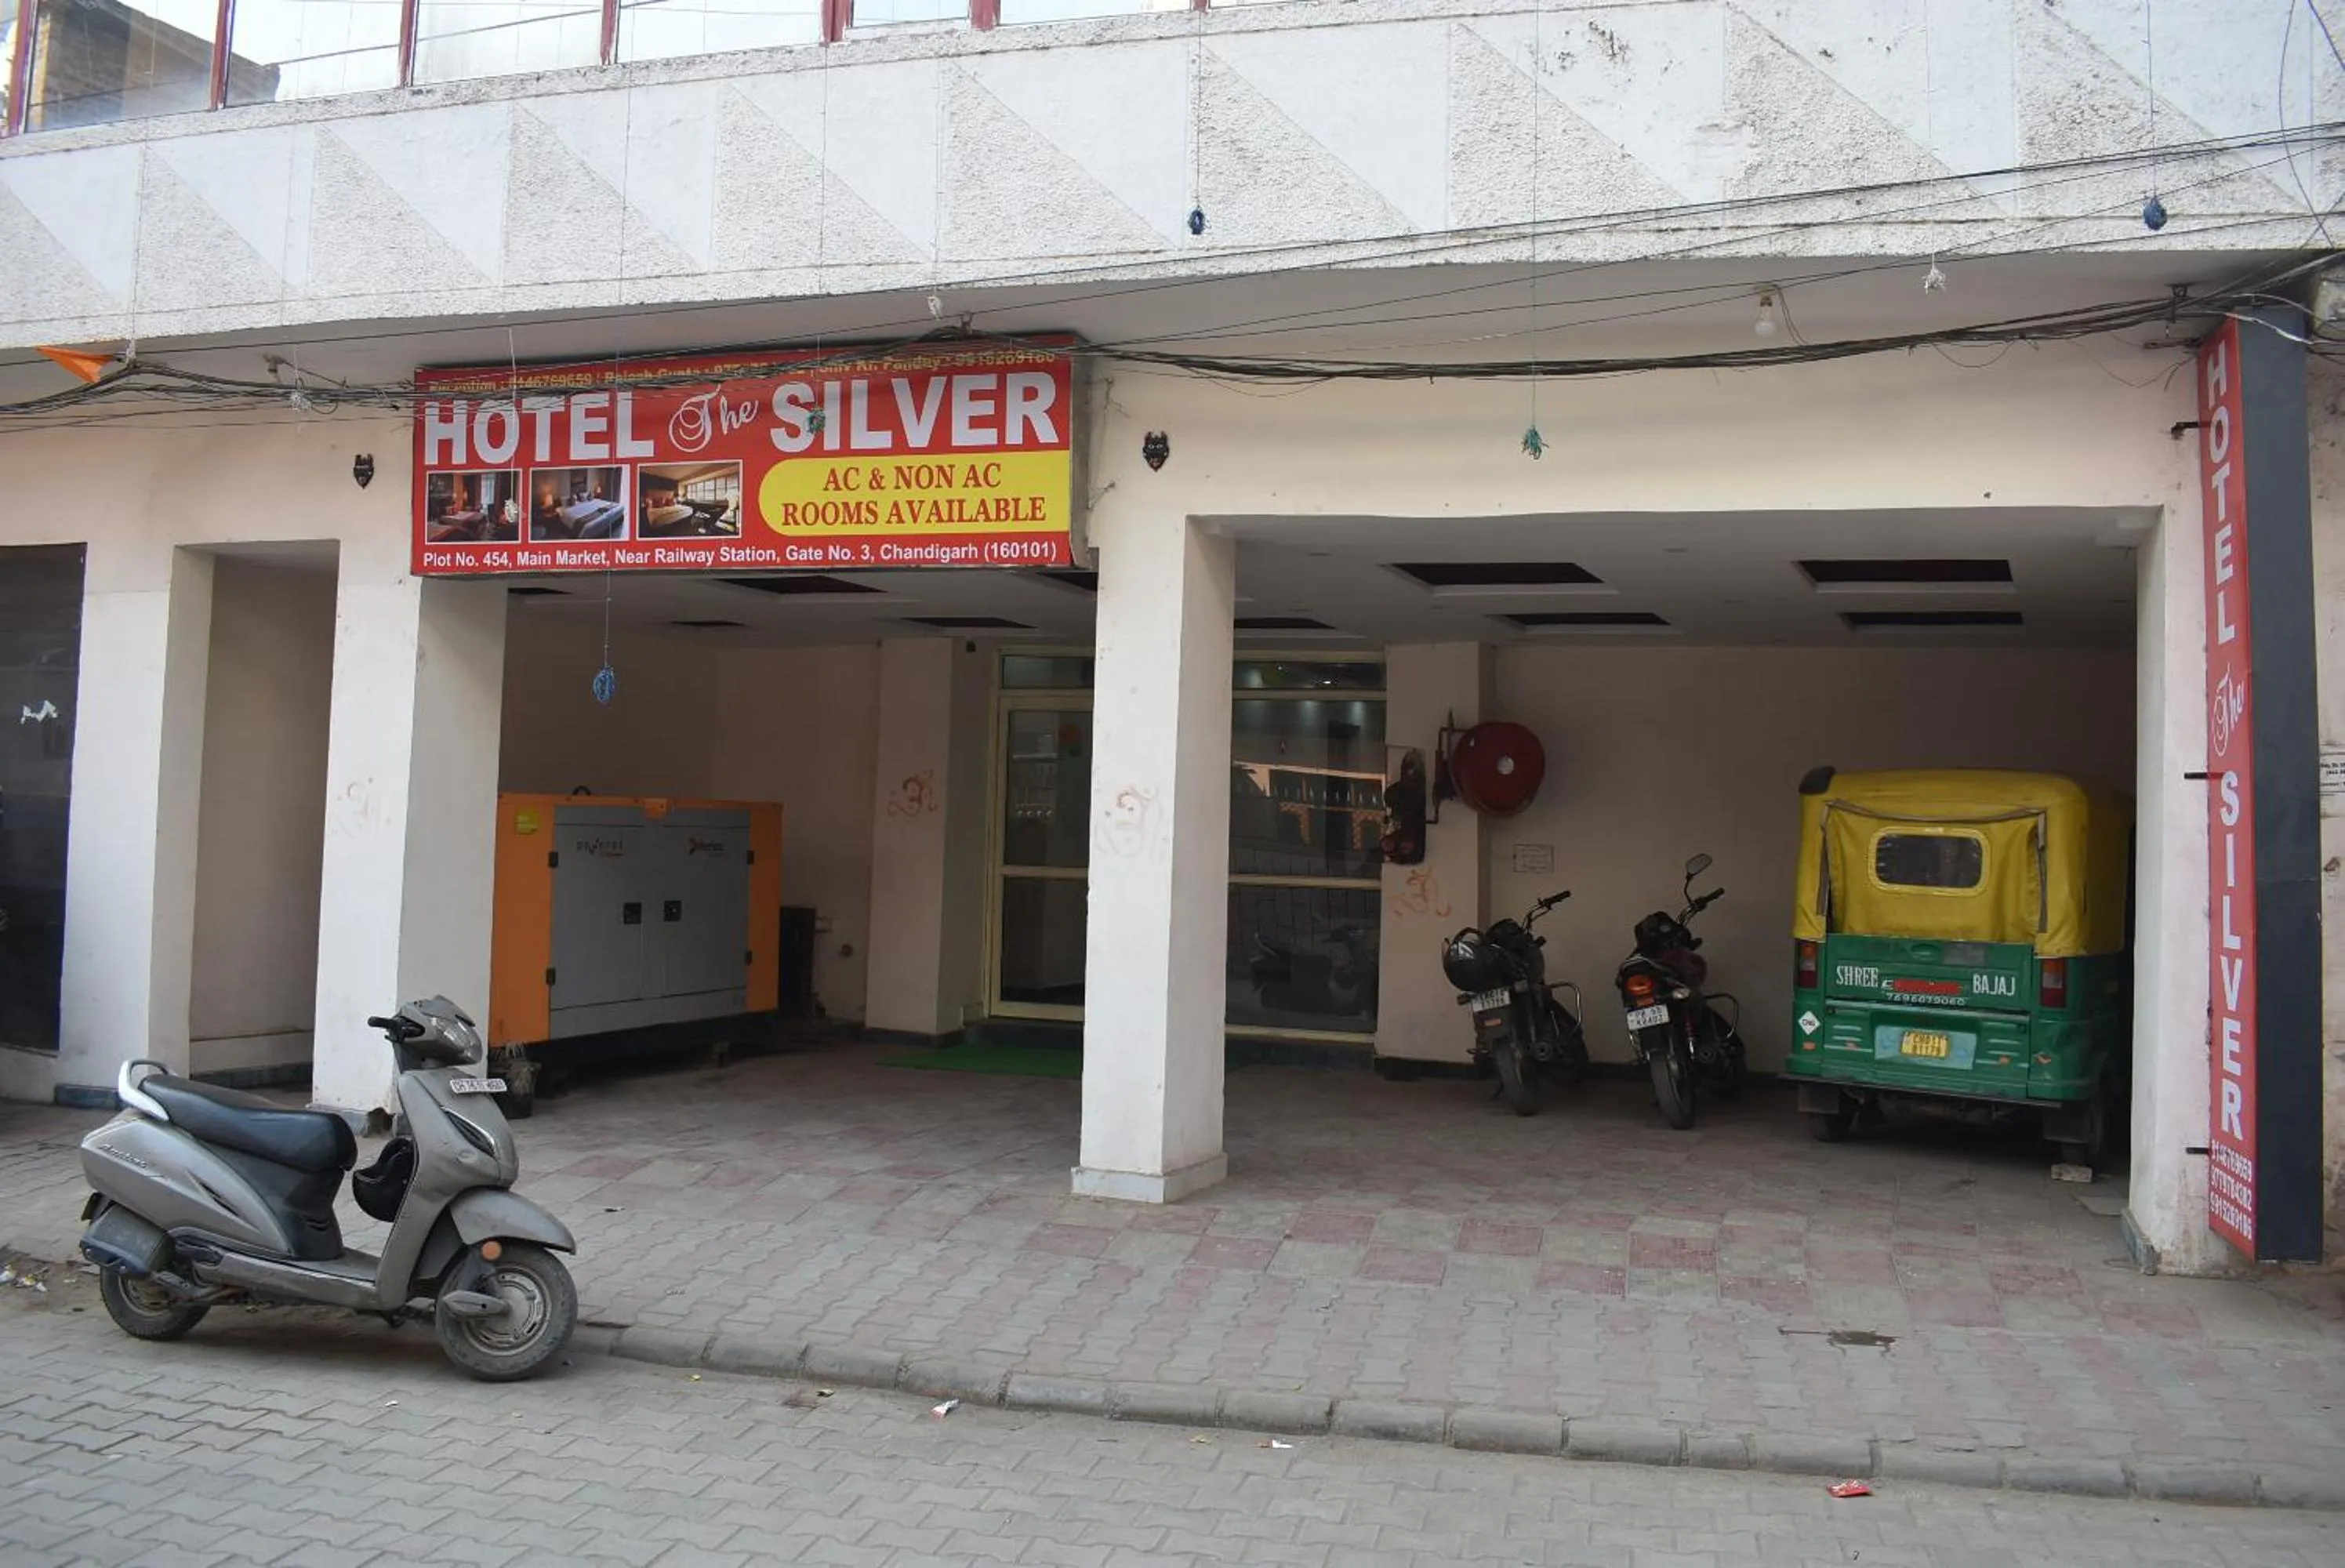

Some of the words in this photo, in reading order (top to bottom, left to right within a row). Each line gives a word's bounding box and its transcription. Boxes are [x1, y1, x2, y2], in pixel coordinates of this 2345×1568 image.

[424, 390, 655, 466] HOTEL
[668, 381, 759, 452] The
[770, 372, 1058, 454] SILVER
[823, 466, 860, 492] AC
[869, 466, 886, 490] &
[893, 463, 956, 490] NON
[962, 462, 1002, 488] AC
[2207, 339, 2236, 645] HOTEL
[782, 499, 879, 526] ROOMS
[885, 495, 1047, 525] AVAILABLE
[423, 552, 451, 567] Plot
[455, 552, 480, 567] No.
[482, 551, 512, 568] 454,
[517, 550, 551, 566] Main
[555, 550, 611, 567] Market,
[615, 550, 651, 564] Near
[654, 547, 714, 568] Railway
[719, 546, 781, 563] Station,
[786, 544, 824, 561] Gate
[828, 544, 855, 561] No.
[860, 544, 874, 563] 3,
[880, 542, 978, 564] Chandigarh
[983, 541, 1057, 562] (160101)
[2212, 662, 2245, 757] The
[2220, 770, 2244, 1141] SILVER
[1835, 965, 1879, 988] SHREE
[1972, 972, 2016, 996] BAJAJ
